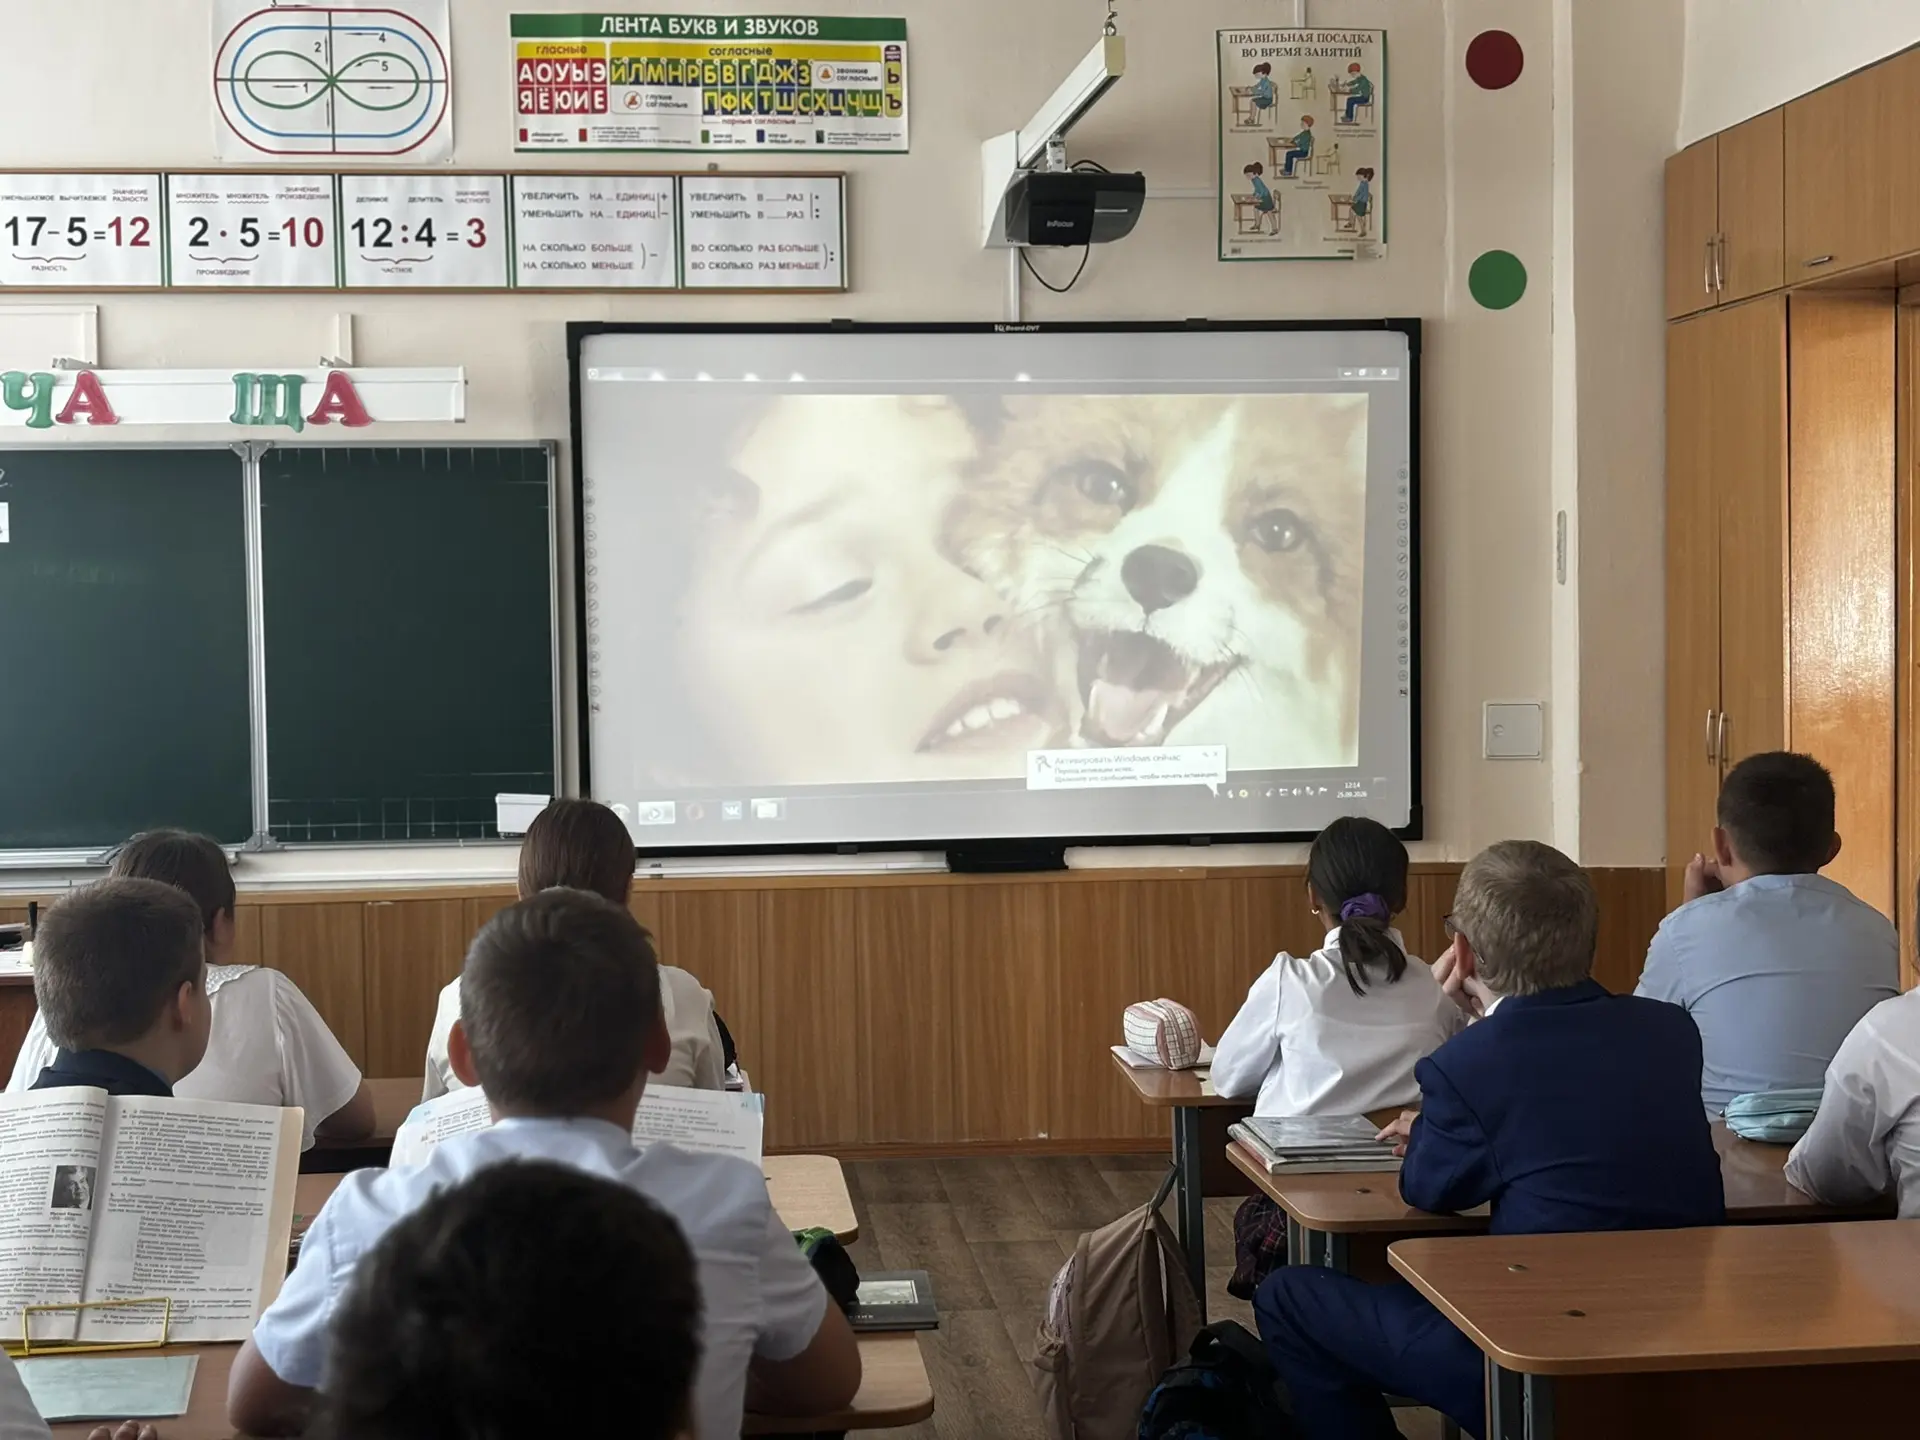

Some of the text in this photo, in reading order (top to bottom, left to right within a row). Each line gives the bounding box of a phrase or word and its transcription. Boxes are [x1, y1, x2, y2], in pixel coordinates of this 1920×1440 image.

[600, 16, 819, 36] ЛЕНТА БУКВ И ЗВУКОВ
[378, 31, 387, 43] 4
[1229, 33, 1374, 45] ПРАВИЛЬНАЯ ПОСАДКА
[313, 42, 322, 53] 2
[536, 46, 588, 55] гласные
[709, 46, 773, 56] согласные
[1242, 46, 1362, 58] ВО ВРЕМЯ ЗАНЯТИЙ
[381, 61, 389, 72] 5
[302, 83, 309, 94] 1
[521, 192, 580, 200] УВЕЛИЧИТЬ
[616, 193, 656, 202] ЕДИНИЦ
[689, 193, 747, 201] УВЕЛИЧИТЬ
[757, 193, 764, 201] В
[521, 210, 656, 219] УМЕНЬШИТЬ НА ЕДИНИЦ
[690, 211, 751, 219] УМЕНЬШИТЬ
[757, 211, 764, 219] В
[523, 243, 634, 252] НА СКОЛЬКО БОЛЬШЕ
[691, 244, 820, 252] ВО СКОЛЬКО РАЗ БОЛЬШЕ
[523, 261, 634, 270] НА СКОЛЬКО МЕНЬШЕ
[691, 262, 821, 270] ВО СКОЛЬКО РАЗ МЕНЬШЕ
[0, 370, 375, 433] ЧА ЩА
[1113, 754, 1151, 763] Windows
